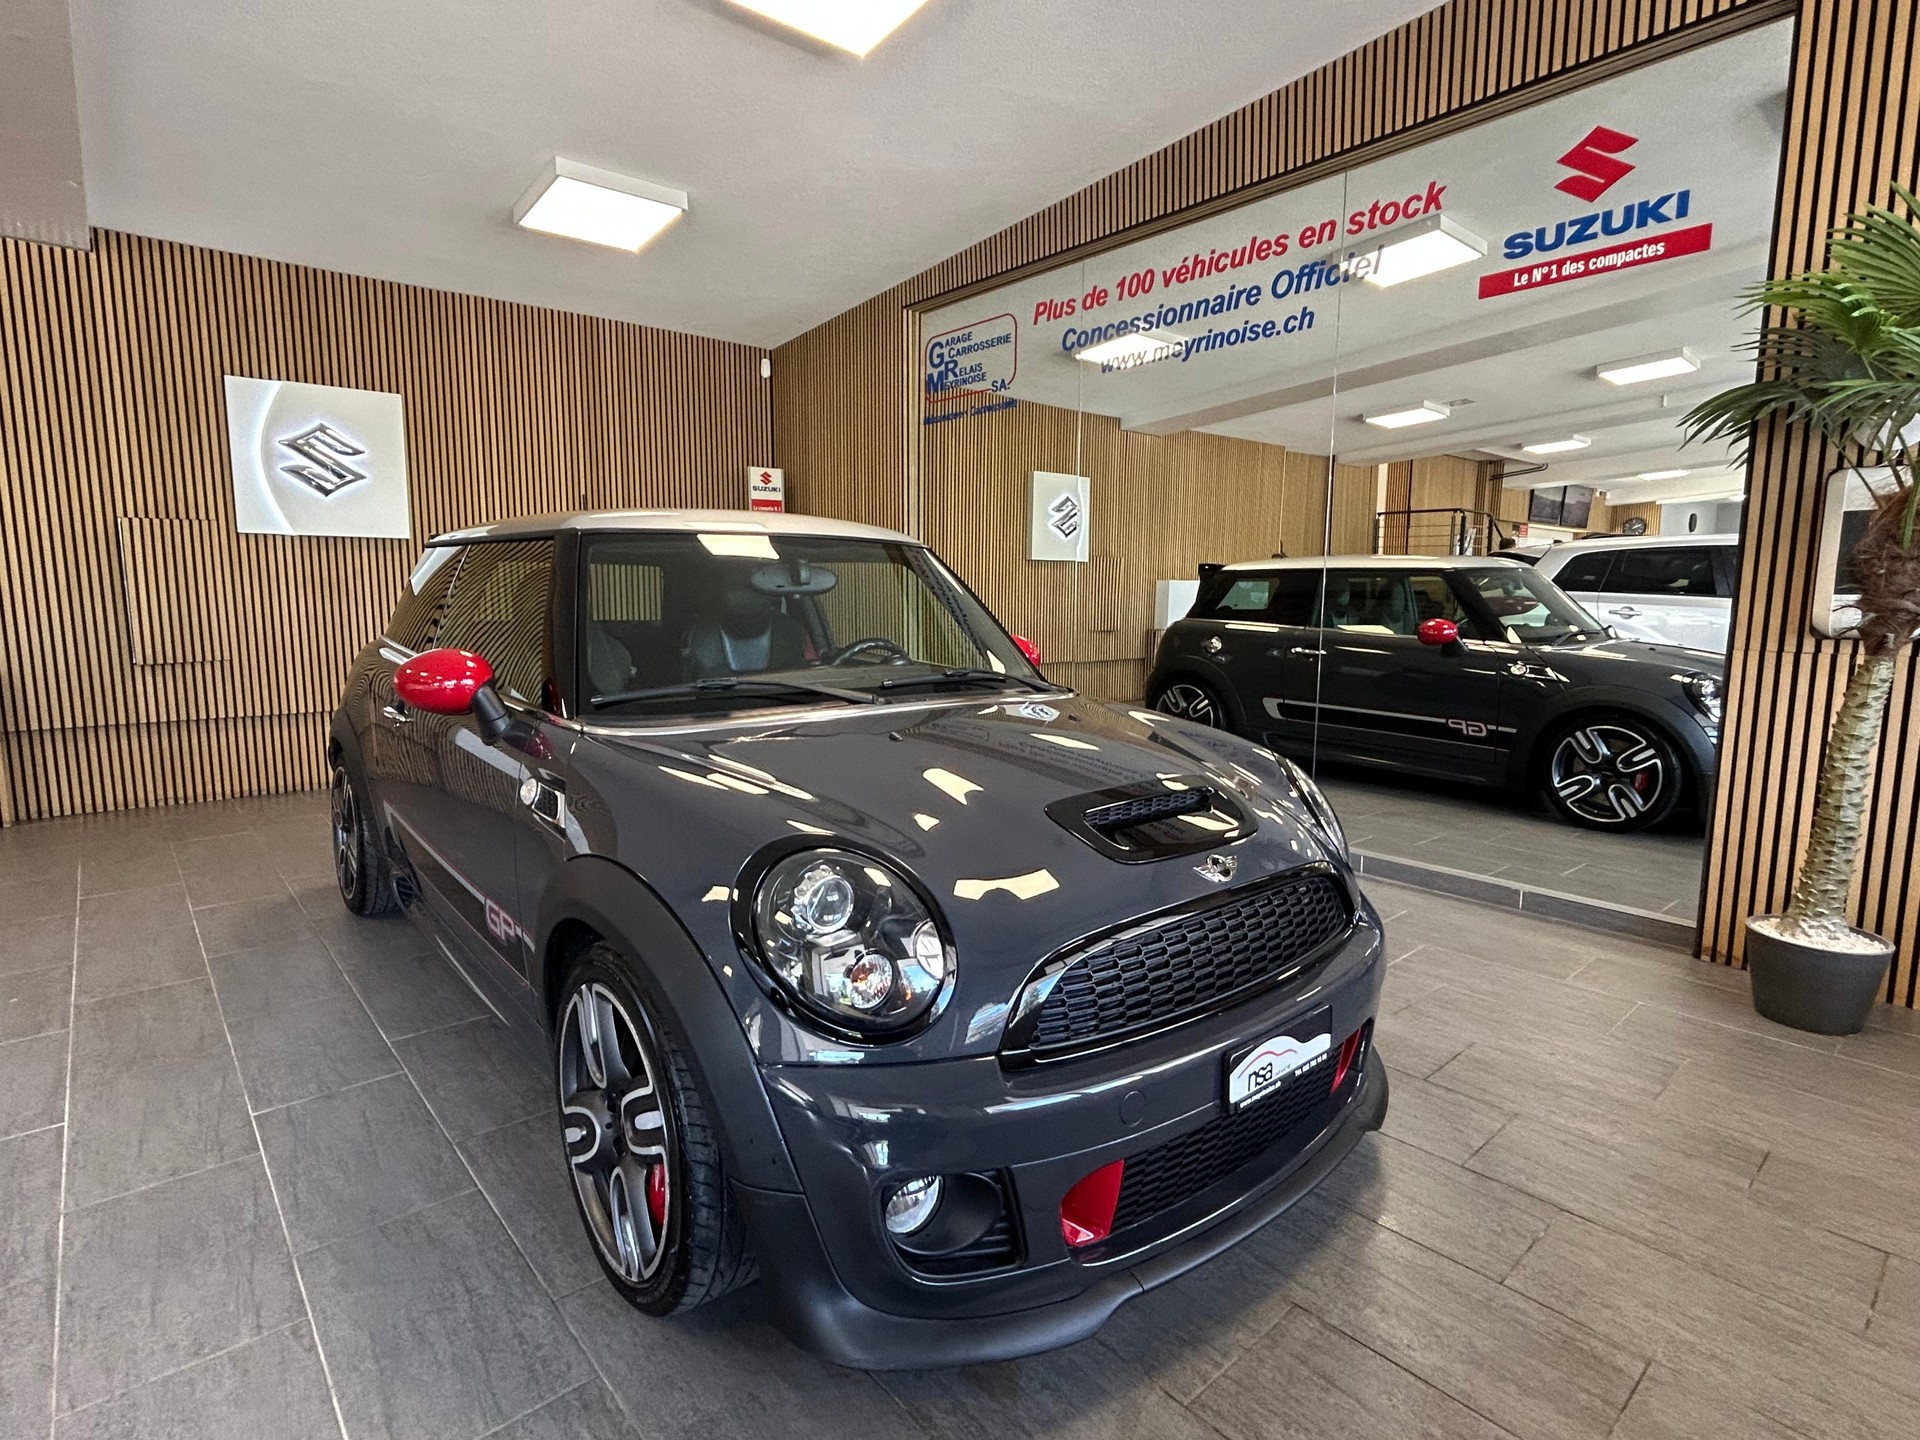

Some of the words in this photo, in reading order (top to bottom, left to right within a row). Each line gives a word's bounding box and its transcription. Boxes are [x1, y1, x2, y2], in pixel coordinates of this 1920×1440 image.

[1033, 300, 1077, 326] Plus
[1082, 285, 1108, 312] de
[1115, 268, 1155, 300] 100
[1163, 232, 1289, 289] véhicules
[1299, 217, 1337, 249] en
[1346, 181, 1447, 236] stock
[1503, 189, 1691, 260] SUZUKI
[1062, 284, 1262, 352] Concessionnaire
[1271, 243, 1385, 299] Officiel
[1513, 271, 1529, 288] Le
[1561, 257, 1585, 277] des
[1588, 241, 1666, 271] compactes
[948, 333, 1012, 359] CARROSSERIE
[1100, 306, 1315, 374] www.meyrinoise.ch
